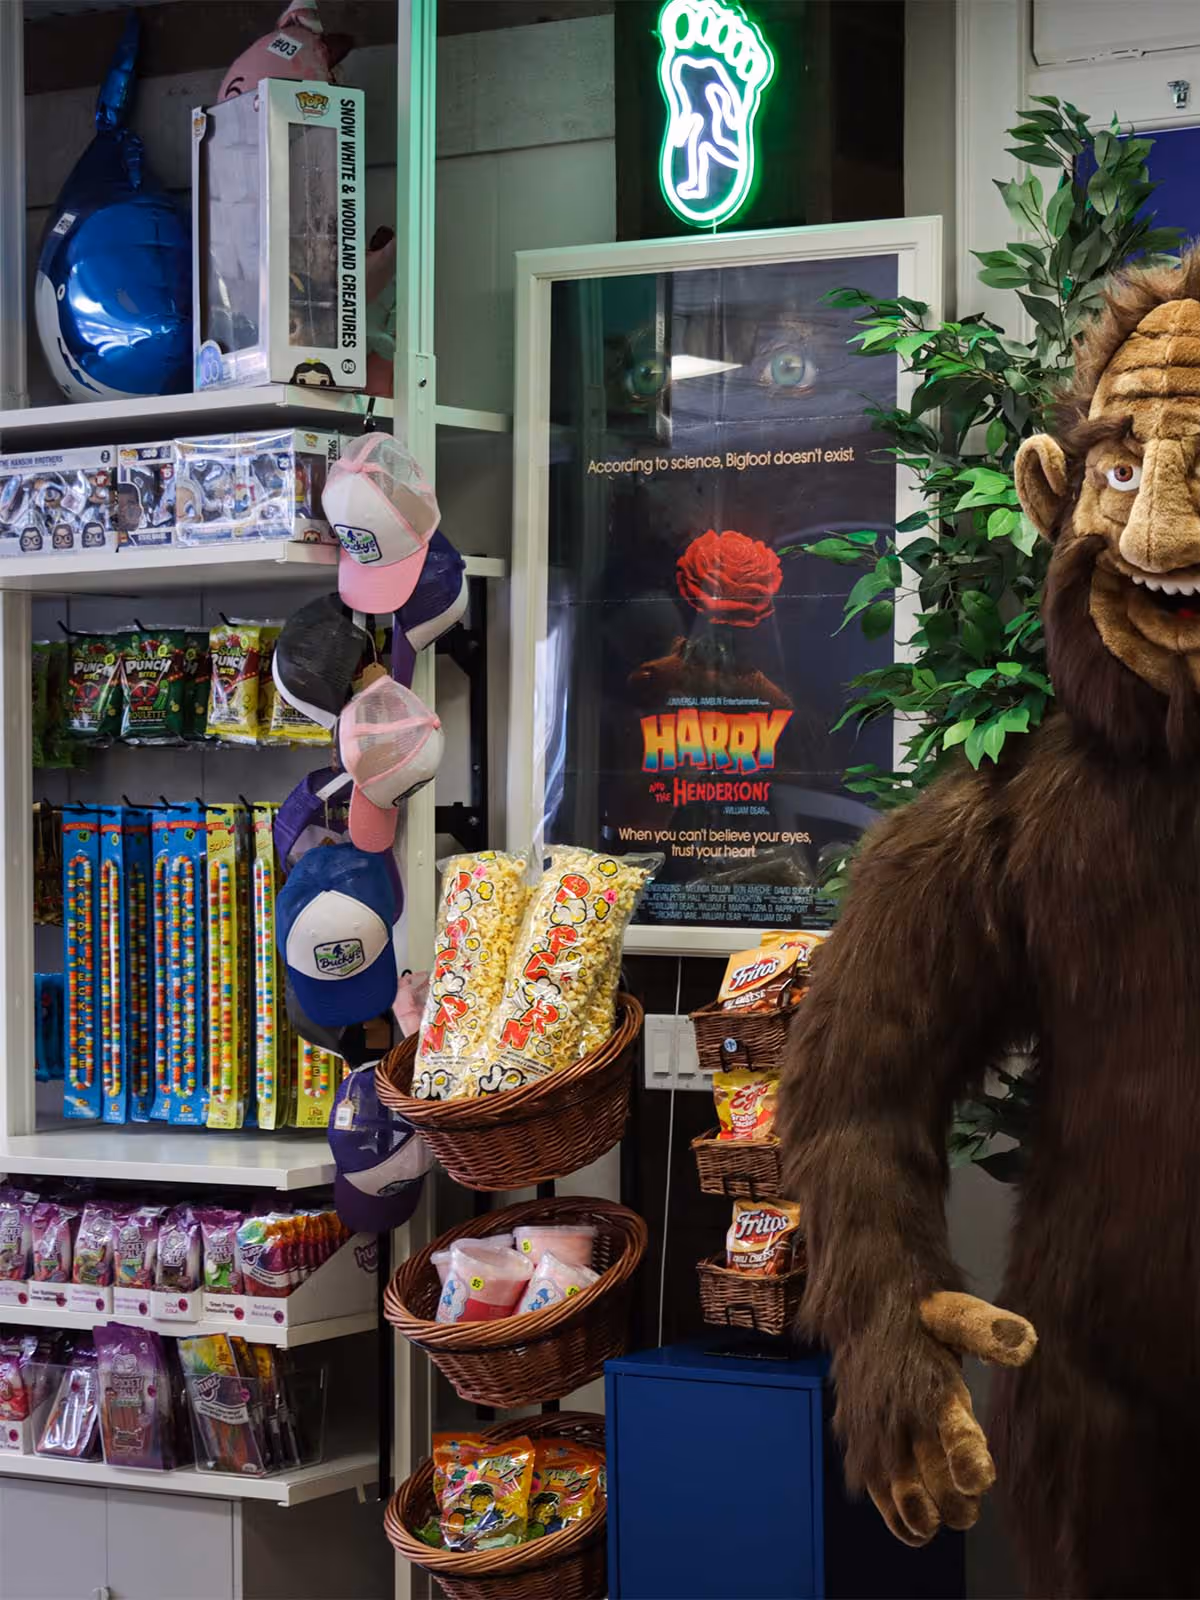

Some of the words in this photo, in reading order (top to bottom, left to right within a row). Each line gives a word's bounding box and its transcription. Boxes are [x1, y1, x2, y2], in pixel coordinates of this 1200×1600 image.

[271, 38, 298, 57] #03
[340, 98, 356, 138] SNOW
[341, 141, 356, 182] WHITE
[341, 184, 356, 195] &
[341, 198, 357, 271] WOODLAND
[341, 274, 357, 349] CREATURES
[342, 361, 355, 373] 09
[587, 458, 654, 476] According
[655, 456, 669, 471] to
[671, 455, 723, 470] science,
[725, 450, 771, 471] Bigfoot
[773, 447, 822, 465] doesn't
[125, 659, 172, 674] PUNCH
[640, 708, 795, 776] HARRY
[655, 793, 671, 803] THE
[673, 777, 772, 808] HENDERSONS
[619, 827, 652, 841] When
[654, 830, 677, 844] you
[679, 828, 708, 842] can't
[709, 828, 751, 843] believe
[753, 830, 780, 844] your
[781, 831, 812, 845] eyes,
[671, 844, 695, 857] trust
[696, 845, 722, 859] your
[728, 957, 780, 993] Fritos
[734, 1209, 789, 1240] Fritos
